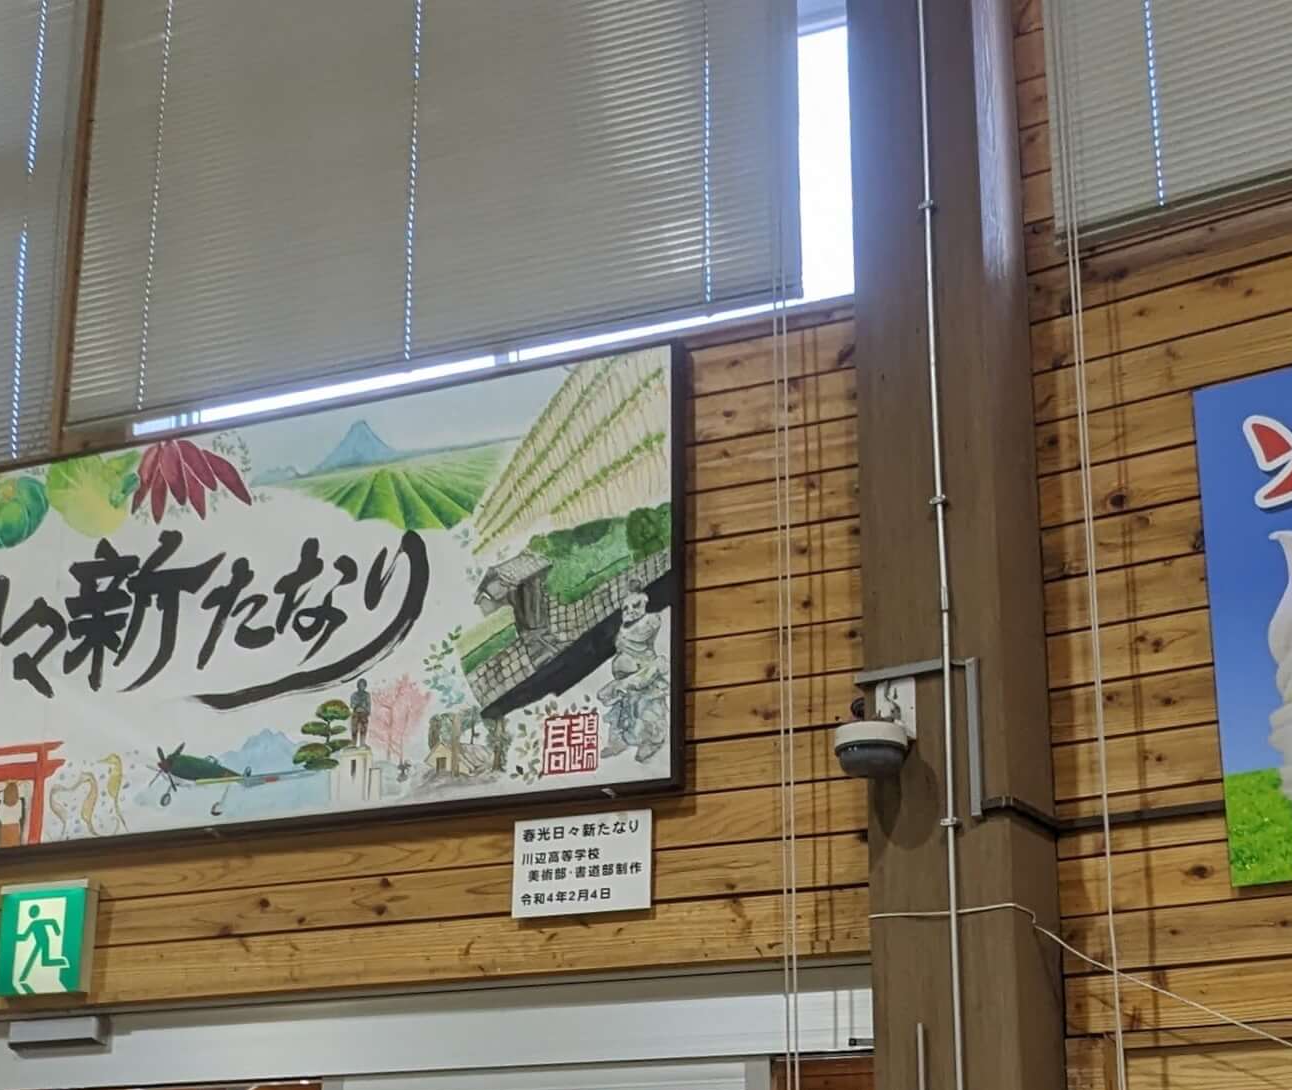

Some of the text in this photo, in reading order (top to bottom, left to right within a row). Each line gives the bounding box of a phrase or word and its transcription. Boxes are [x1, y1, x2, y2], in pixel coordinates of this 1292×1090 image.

[522, 819, 640, 843] 春光日々新たなり
[521, 848, 601, 866] 川辺高等学校
[521, 887, 612, 906] 令和4年2月4日
